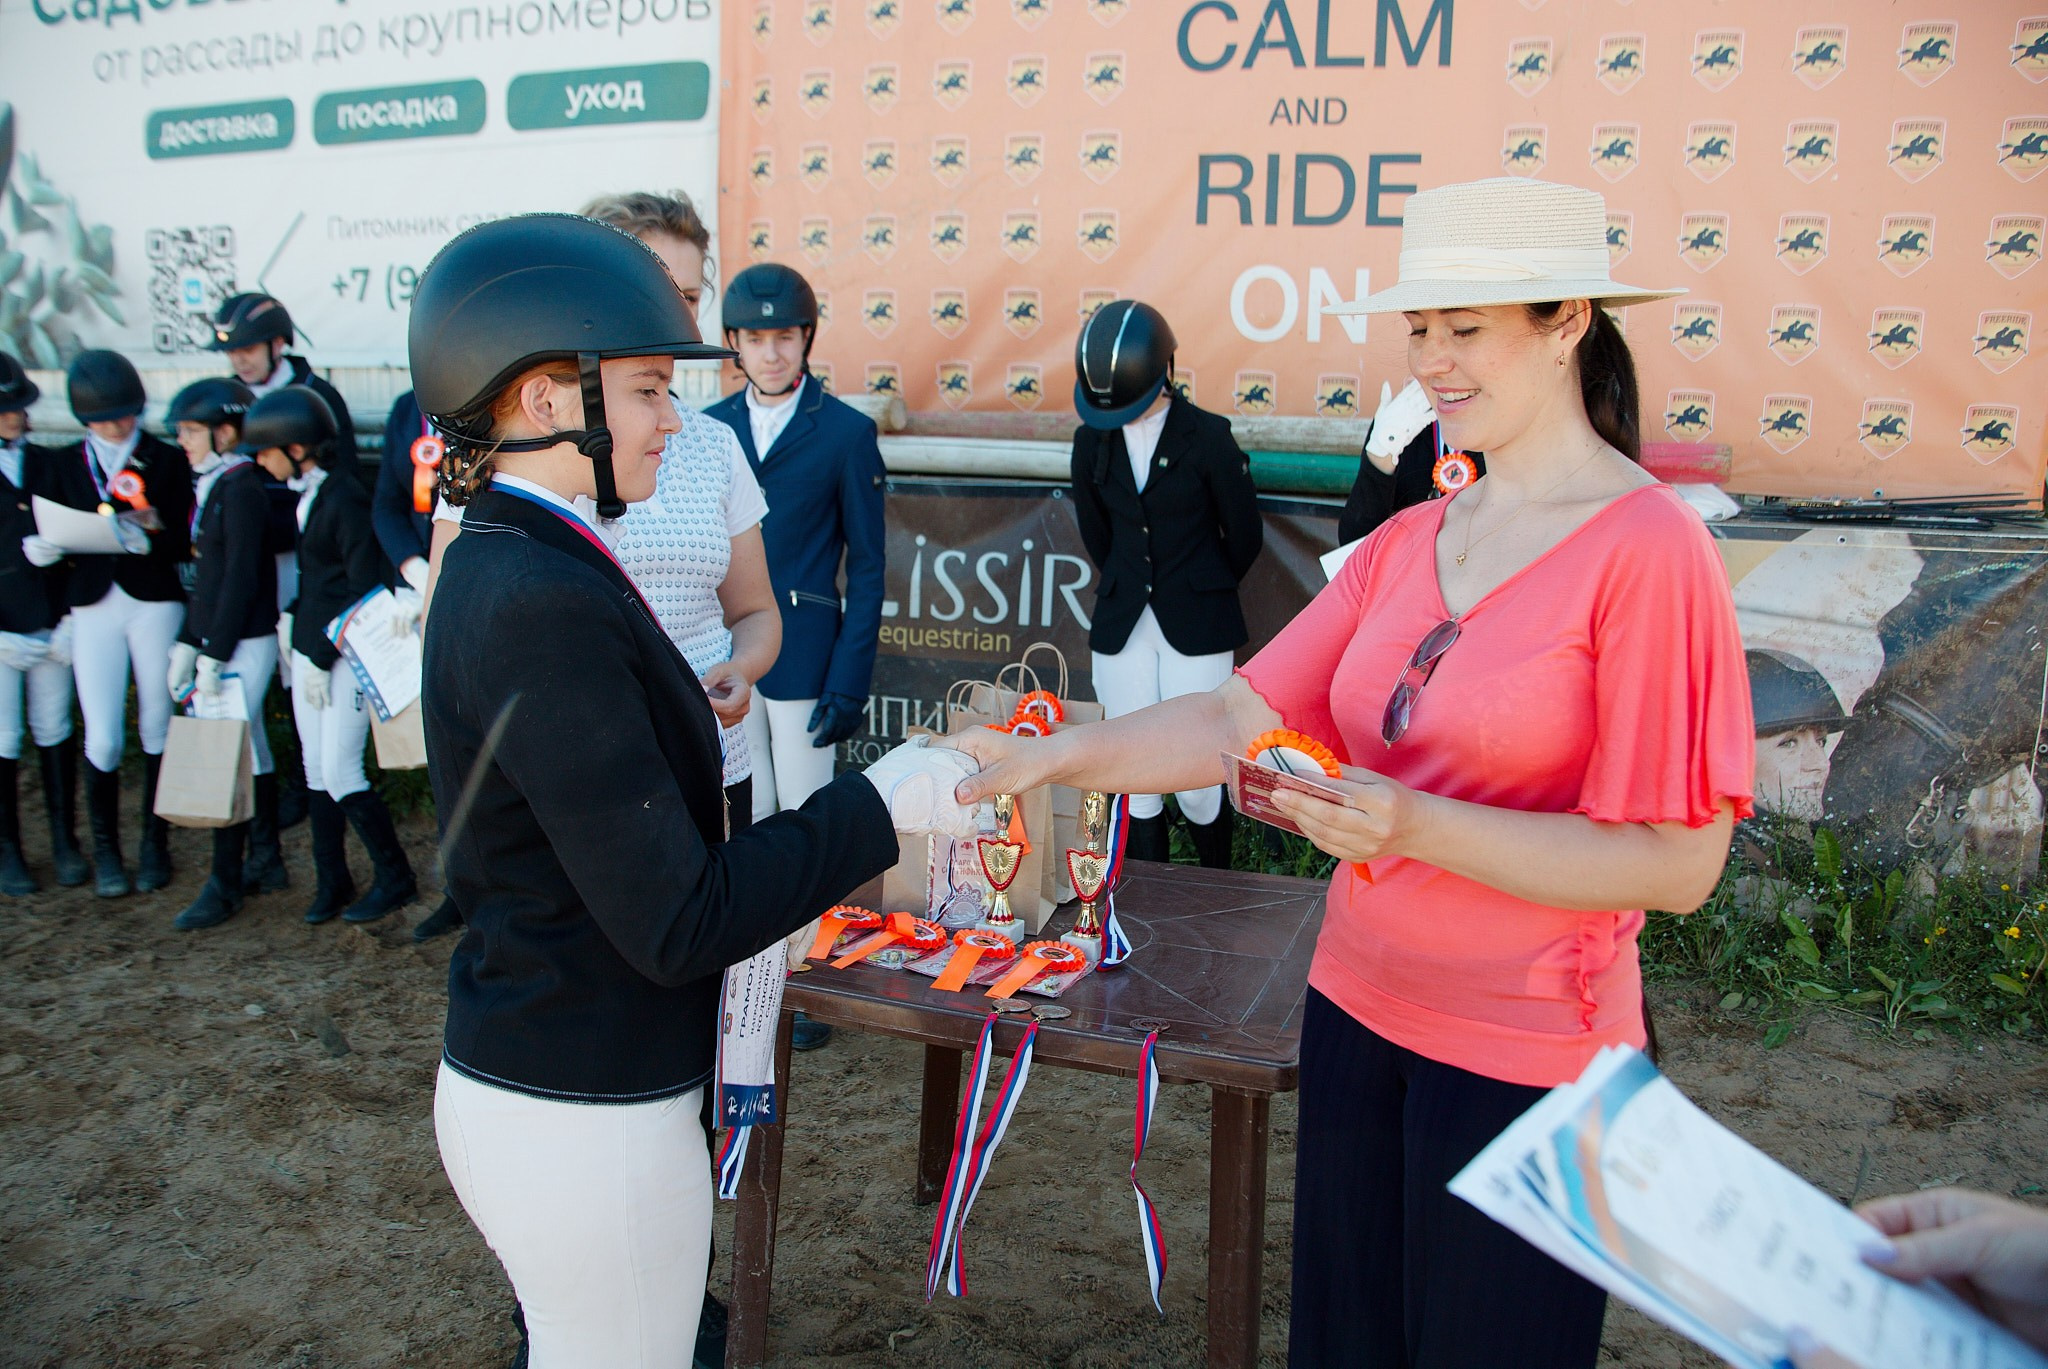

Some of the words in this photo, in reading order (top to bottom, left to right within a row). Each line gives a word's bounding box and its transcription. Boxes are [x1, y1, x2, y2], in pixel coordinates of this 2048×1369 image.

[1177, 0, 1454, 72] CALM
[1801, 30, 1842, 41] FREERIDE
[1908, 25, 1953, 36] FREERIDE
[93, 53, 131, 83] от
[141, 30, 302, 85] рассады
[312, 22, 366, 65] до
[377, 0, 713, 57] крупномеров
[564, 81, 645, 118] уход
[337, 95, 458, 131] посадка
[1269, 97, 1348, 125] AND
[159, 110, 279, 149] доставка
[1898, 123, 1941, 133] FREERIDE
[1196, 153, 1422, 227] RIDE
[327, 213, 449, 241] Питомник
[1785, 217, 1825, 227] FREERIDE
[1888, 217, 1930, 228] FREERIDE
[1997, 218, 2040, 229] FREERIDE
[331, 268, 370, 302] +7
[1229, 264, 1370, 345] ON
[1777, 308, 1816, 319] FREERIDE
[1878, 312, 1920, 323] FREERIDE
[1984, 315, 2028, 326] FREERIDE
[1770, 397, 1808, 409] FREERIDE
[1868, 403, 1908, 414] FREERIDE
[1972, 409, 2014, 419] FREERIDE
[878, 625, 1011, 653] equestrian
[757, 960, 772, 1032] КОЛОСОВА
